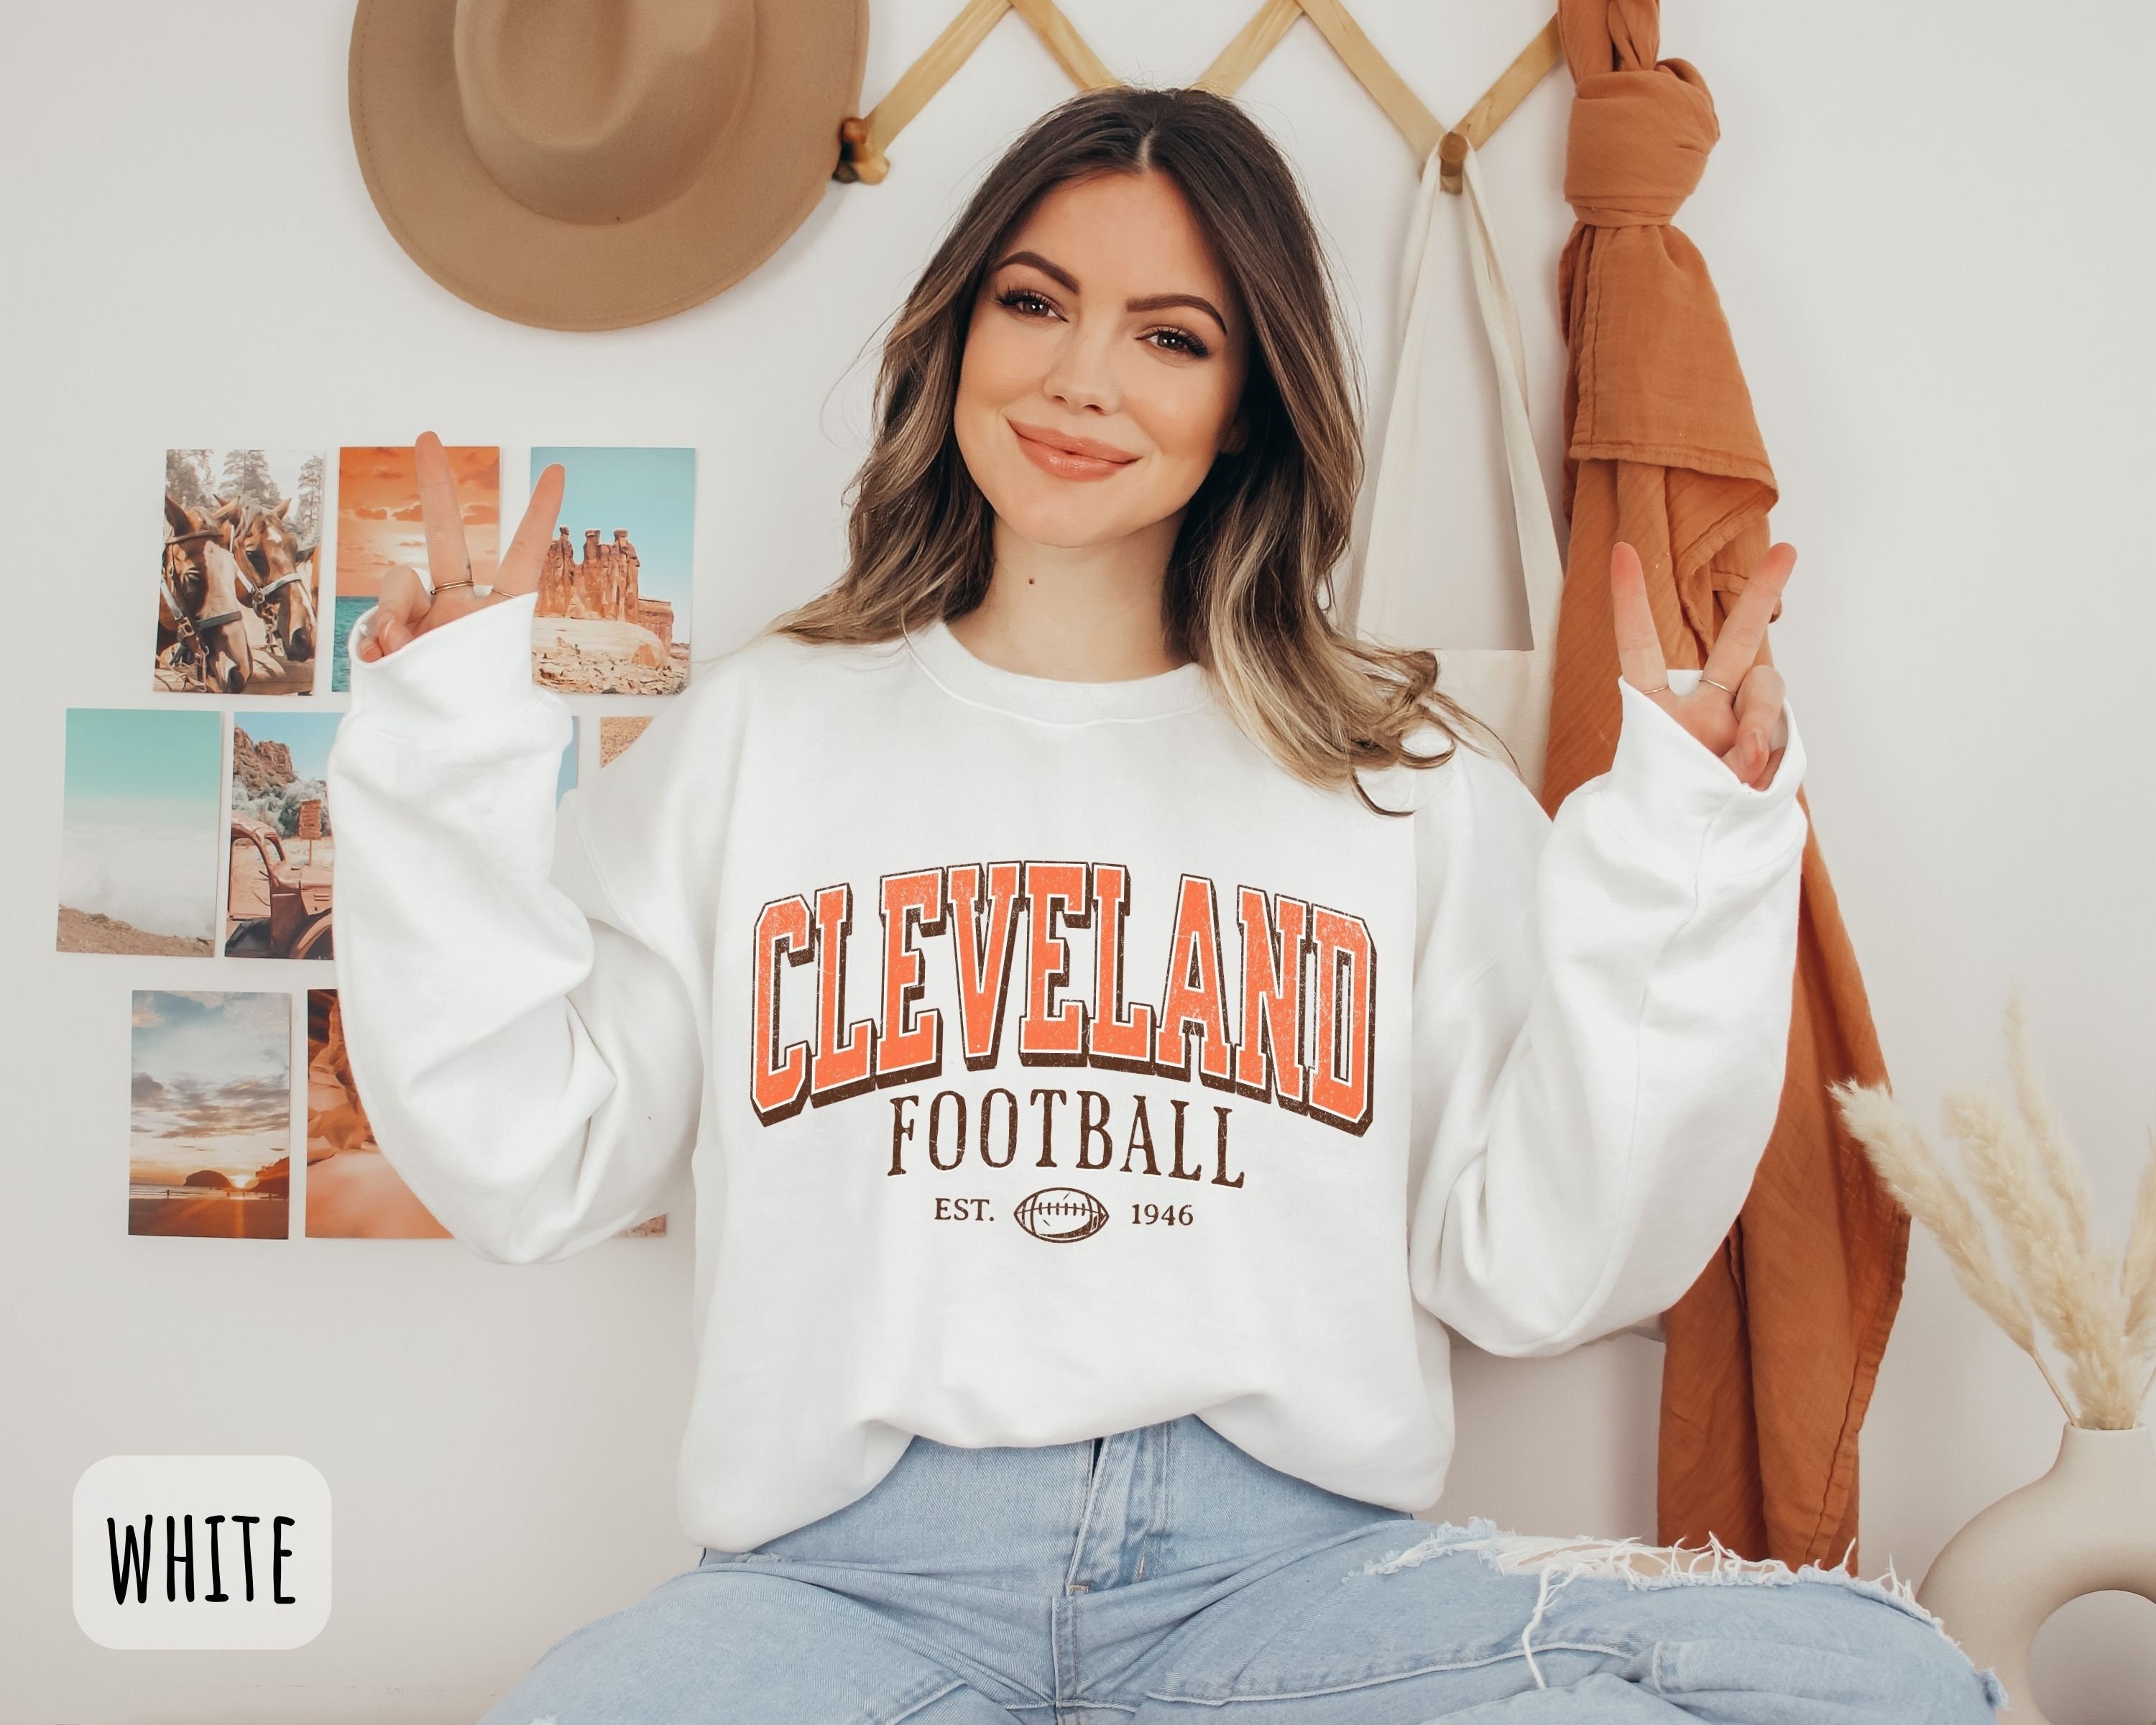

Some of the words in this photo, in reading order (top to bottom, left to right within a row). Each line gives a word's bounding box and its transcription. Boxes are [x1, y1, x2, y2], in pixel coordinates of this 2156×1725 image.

[750, 860, 1378, 1138] CLEVELAND
[887, 1087, 1245, 1189] FOOTBALL
[934, 1197, 995, 1222] EST.
[1131, 1203, 1194, 1226] 1946
